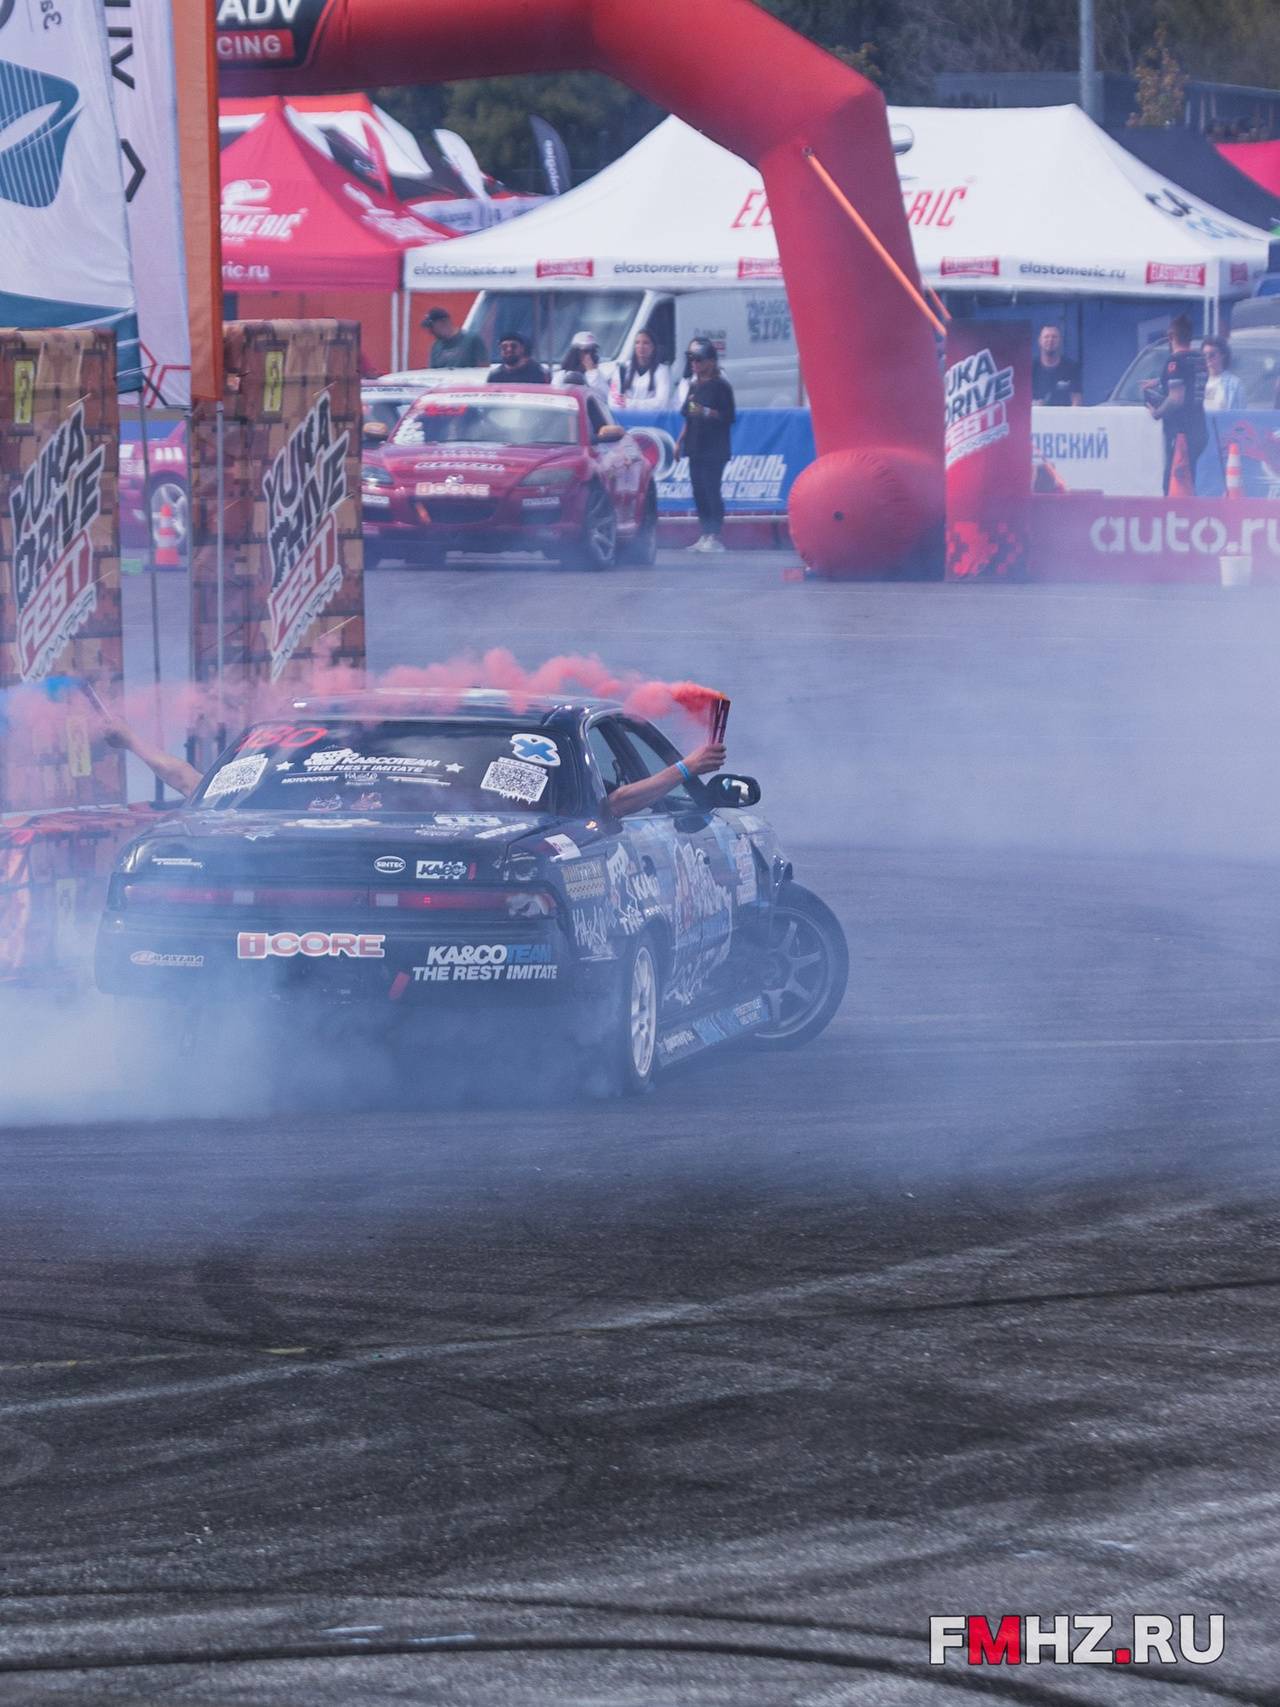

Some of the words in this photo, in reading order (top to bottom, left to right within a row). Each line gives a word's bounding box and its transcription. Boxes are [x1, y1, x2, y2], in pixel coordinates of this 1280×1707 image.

[413, 261, 518, 276] elastomeric.ru
[613, 259, 719, 275] elastomeric.ru
[1019, 261, 1127, 279] elastomeric.ru
[10, 403, 85, 549] YUKA
[21, 540, 89, 669] FEST
[335, 764, 371, 772] REST
[372, 764, 426, 773] IMITATE
[376, 861, 405, 869] SINTEC
[413, 966, 451, 981] THE
[452, 966, 504, 981] REST
[506, 964, 558, 980] IMITATE
